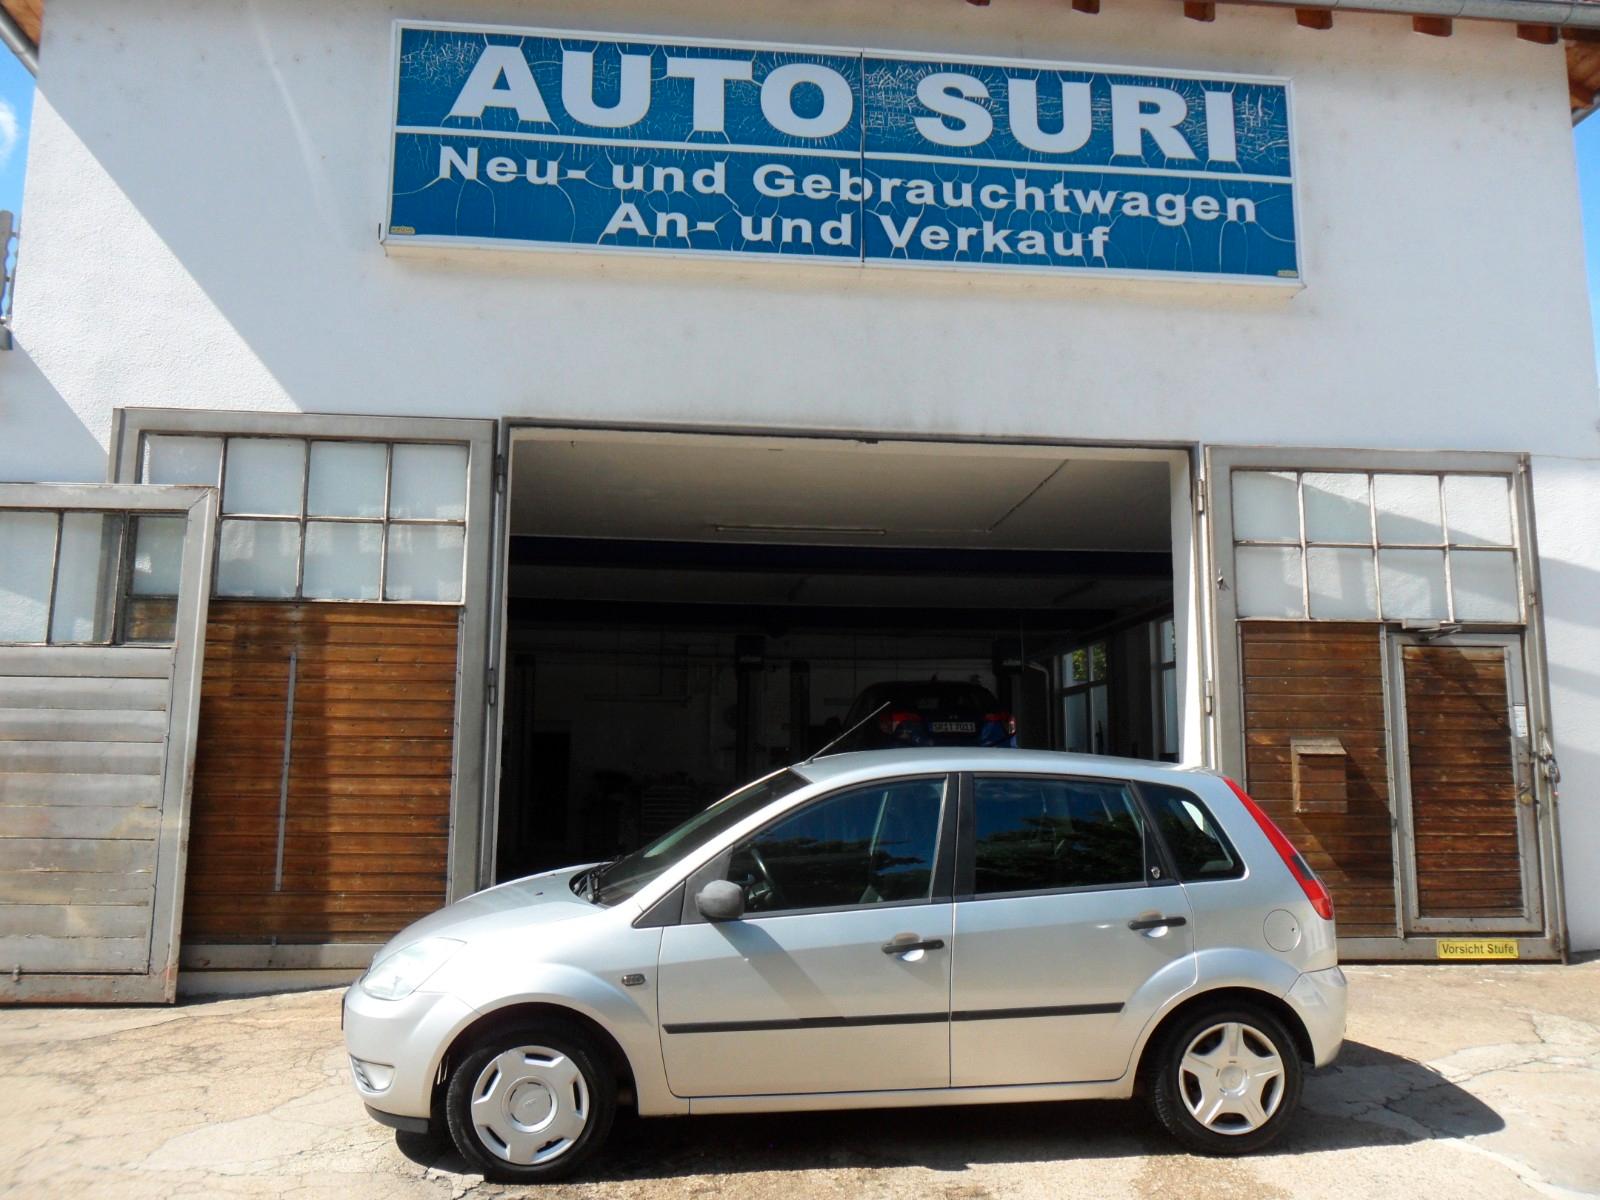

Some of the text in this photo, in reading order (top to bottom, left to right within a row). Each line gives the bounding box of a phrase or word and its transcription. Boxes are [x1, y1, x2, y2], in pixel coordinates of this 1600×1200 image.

[448, 45, 1236, 162] AUTO SURI
[439, 145, 1257, 226] Neu- und Gebrauchtwagen
[602, 202, 1110, 256] An- und Verkauf
[1442, 943, 1514, 954] Vorsicht Stufe
